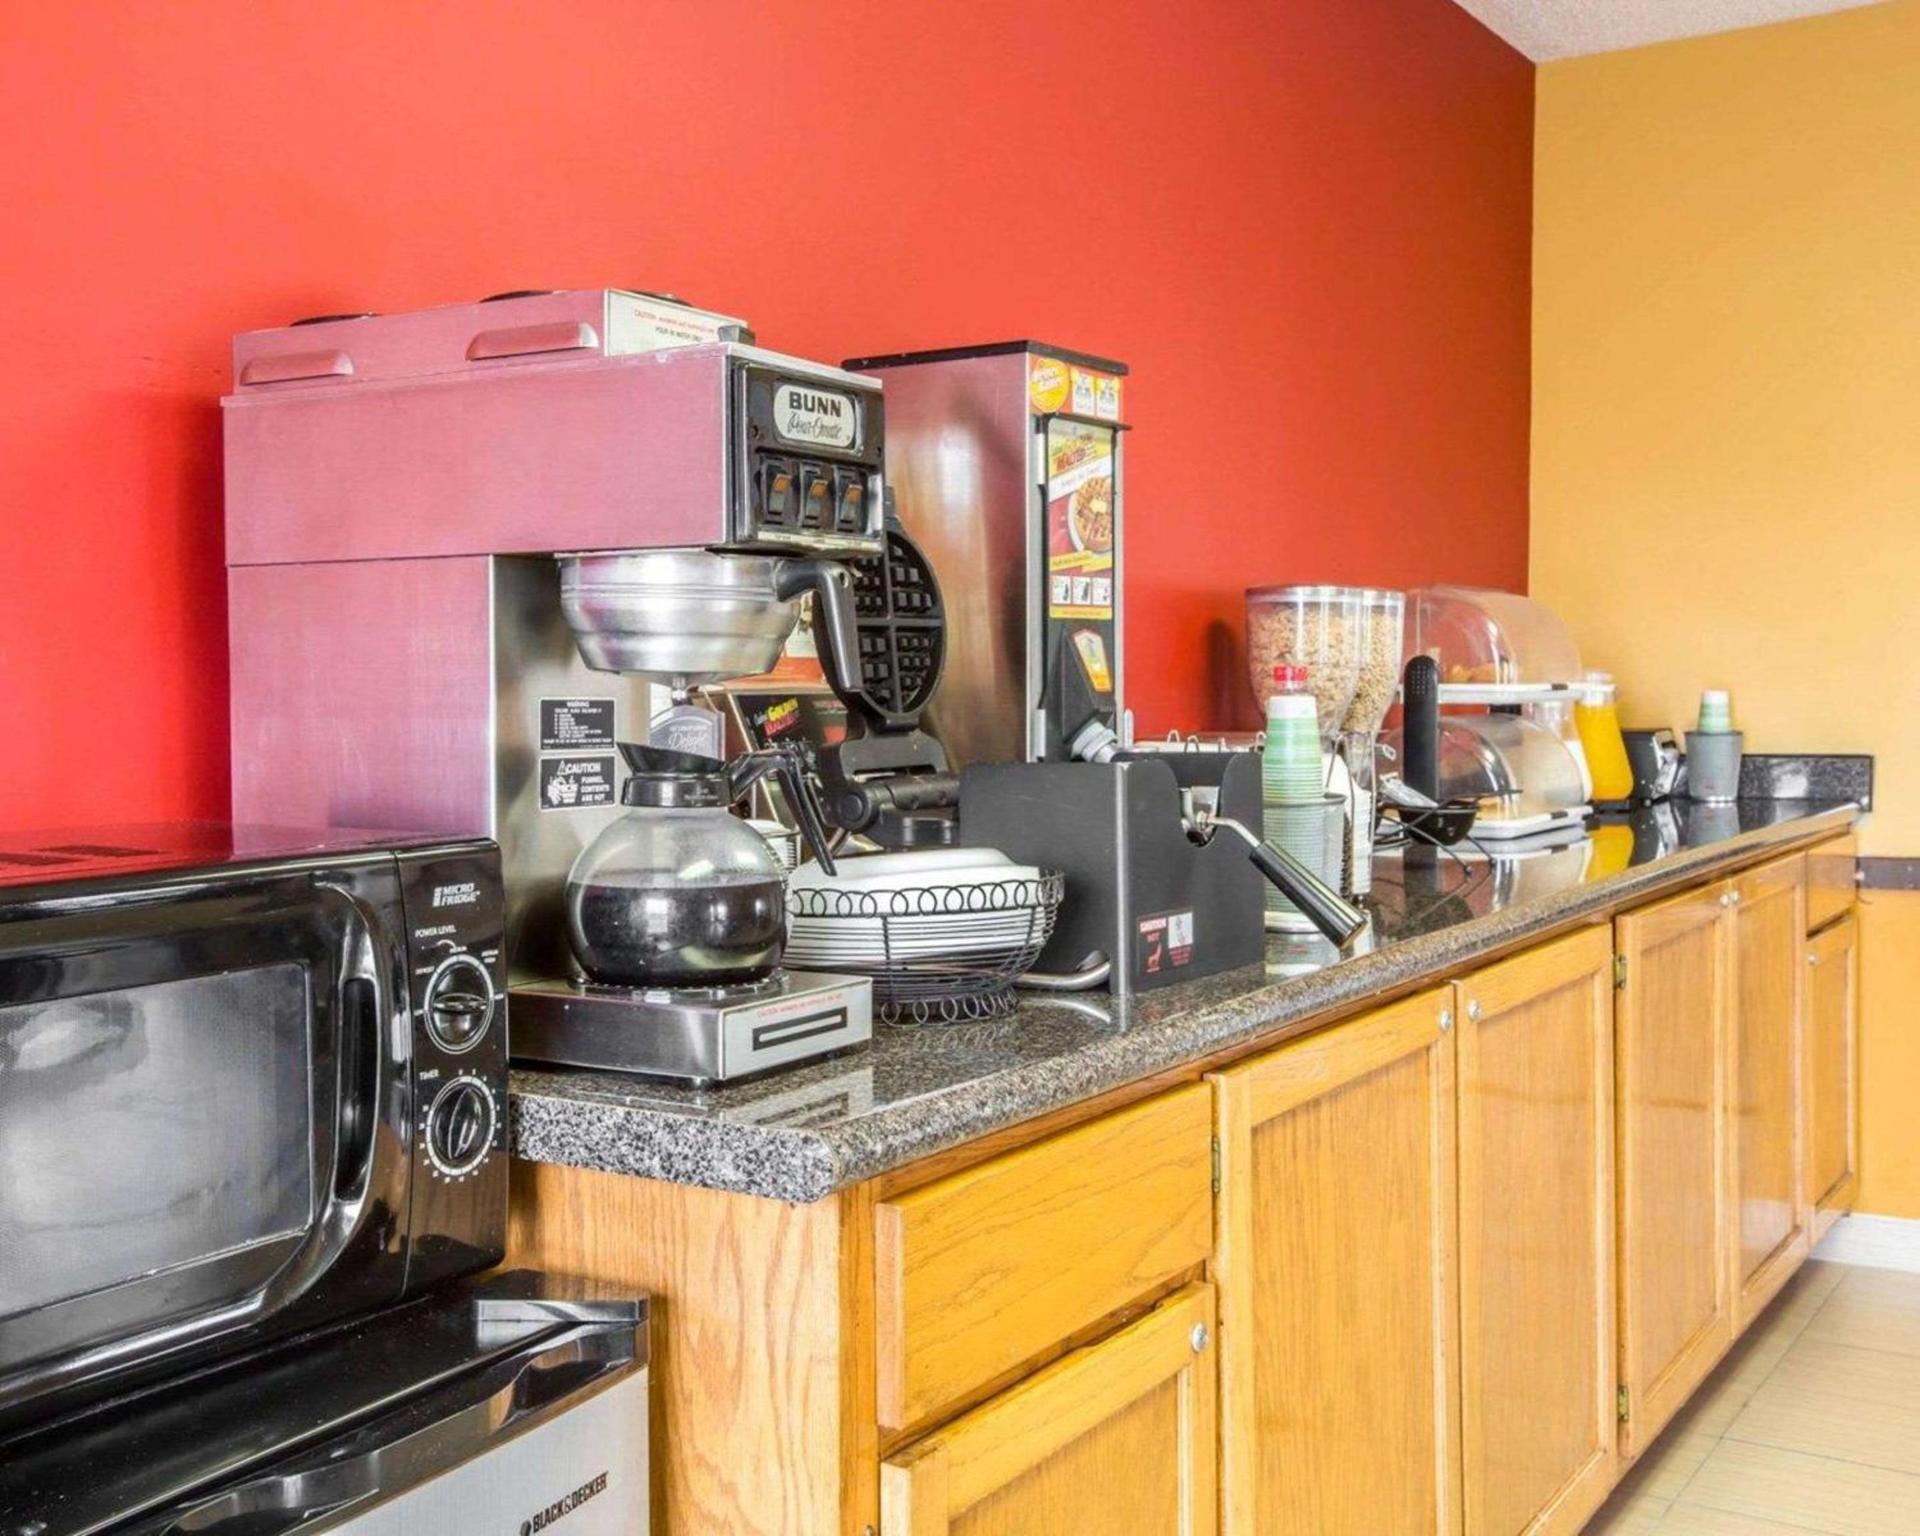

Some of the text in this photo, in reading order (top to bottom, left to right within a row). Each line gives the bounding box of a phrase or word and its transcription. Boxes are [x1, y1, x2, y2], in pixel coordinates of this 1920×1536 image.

[789, 391, 842, 418] BUNN
[565, 762, 602, 774] CAUTION
[443, 883, 475, 896] MICRO
[441, 892, 477, 906] FRIDGE
[415, 924, 457, 938] POWER LEVEL
